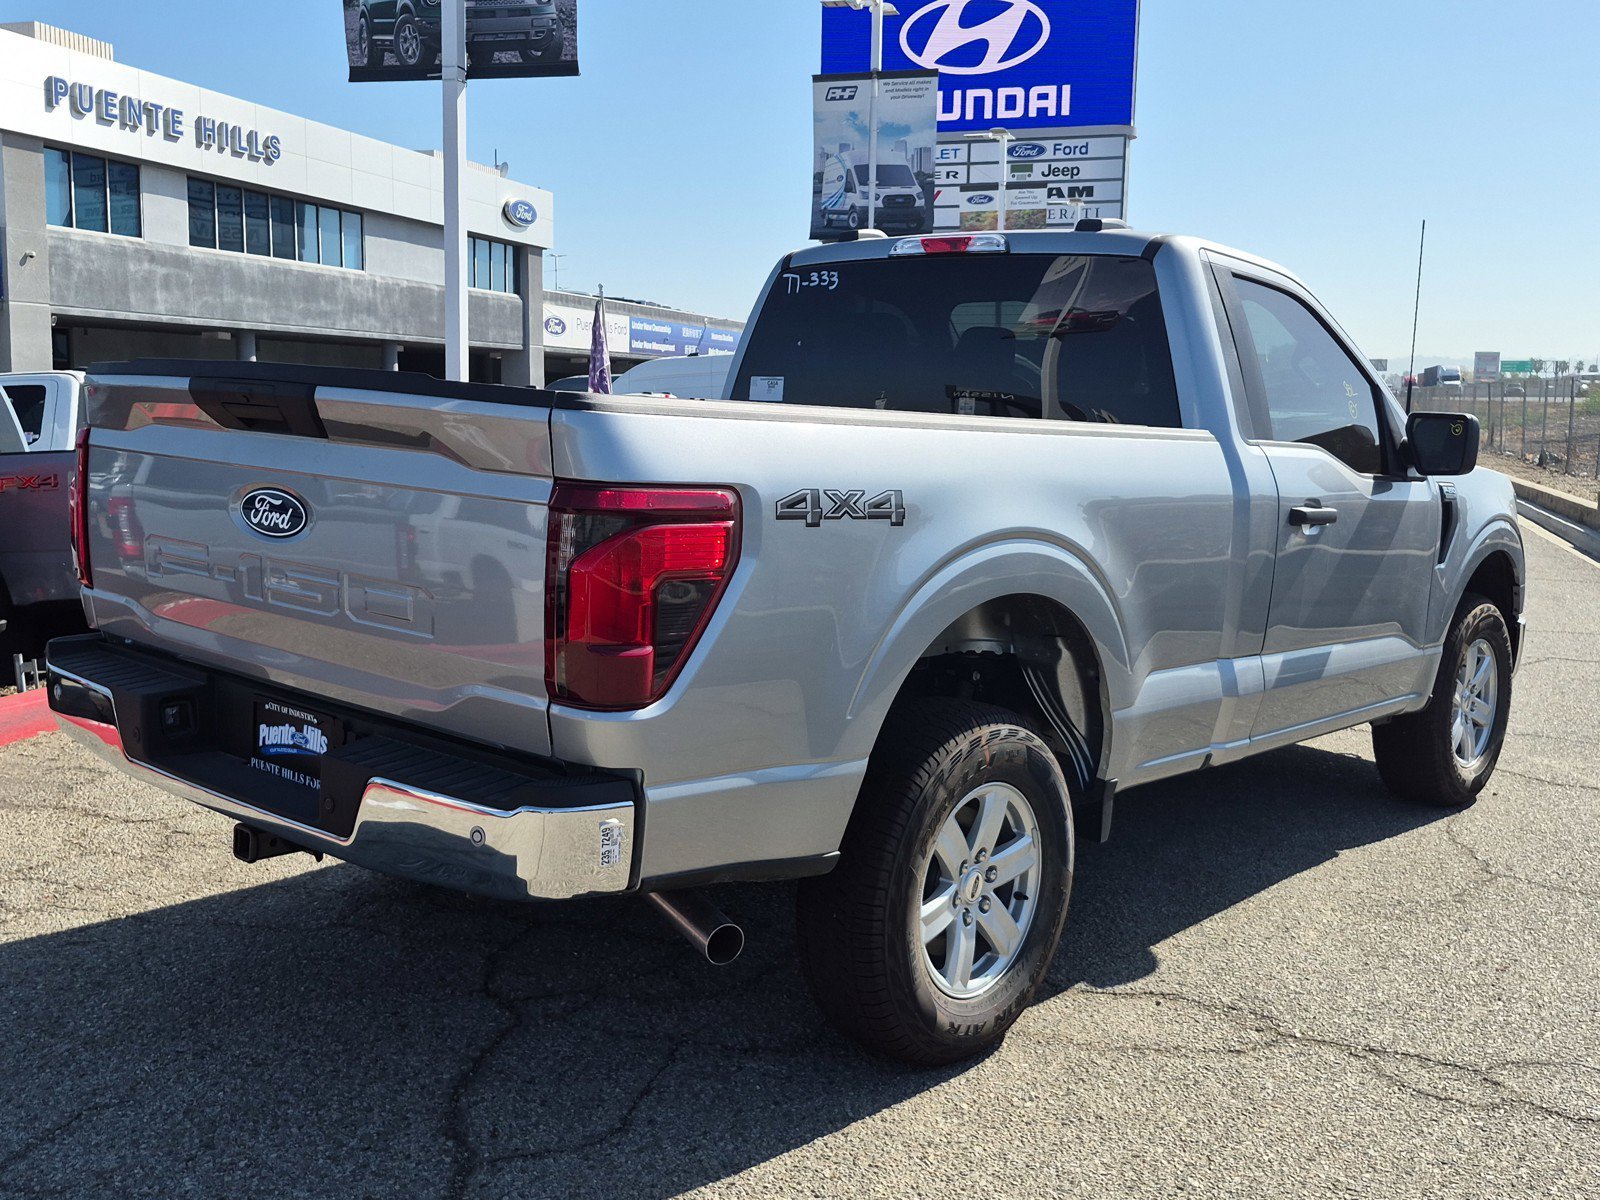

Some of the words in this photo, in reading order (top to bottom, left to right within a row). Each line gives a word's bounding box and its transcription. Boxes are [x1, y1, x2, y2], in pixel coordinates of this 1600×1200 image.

[937, 84, 1071, 121] UNDAI
[48, 76, 184, 140] PUENTE
[198, 116, 282, 163] HILLS
[1053, 142, 1089, 156] Ford
[1041, 164, 1080, 179] Jeep
[1047, 186, 1094, 199] AM
[576, 317, 592, 331] Puen
[615, 323, 627, 335] Ford
[0, 474, 58, 493] FX4
[250, 495, 293, 530] Ford
[145, 534, 435, 638] F-150
[268, 702, 280, 712] CITY
[281, 706, 288, 714] OF
[288, 707, 315, 721] INDUSTRY
[259, 723, 297, 747] Puente
[303, 724, 328, 755] Hills
[250, 757, 280, 776] PUENTE
[281, 767, 305, 784] HILLS
[305, 775, 320, 790] FOR
[601, 850, 611, 866] 235
